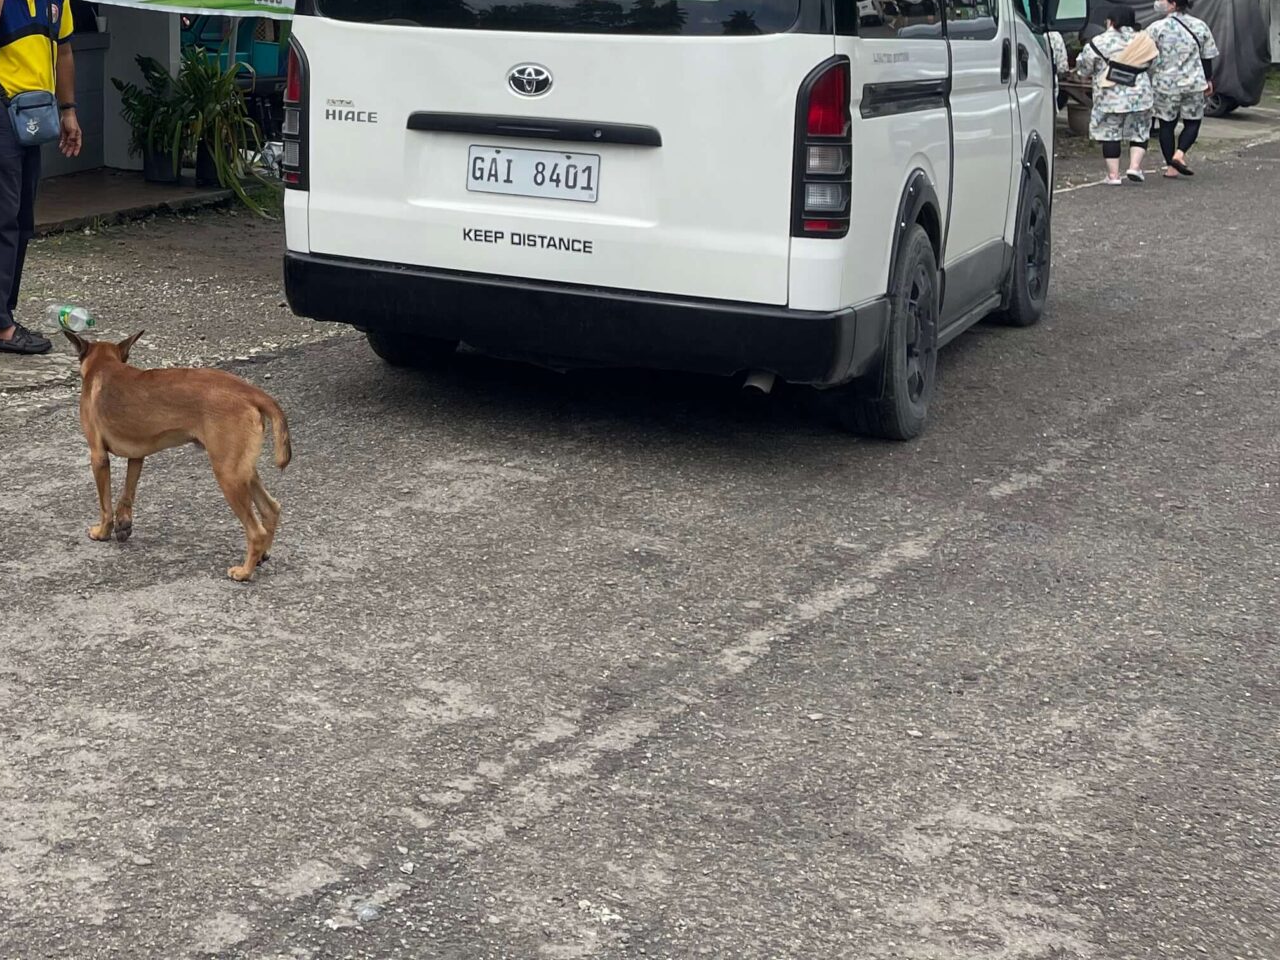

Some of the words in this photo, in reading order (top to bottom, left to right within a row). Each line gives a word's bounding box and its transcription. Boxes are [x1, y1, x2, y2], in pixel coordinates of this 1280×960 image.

[325, 109, 377, 123] HIACE
[471, 156, 513, 184] GAI
[533, 161, 593, 191] 8401
[463, 228, 505, 243] KEEP
[511, 232, 593, 254] DISTANCE
